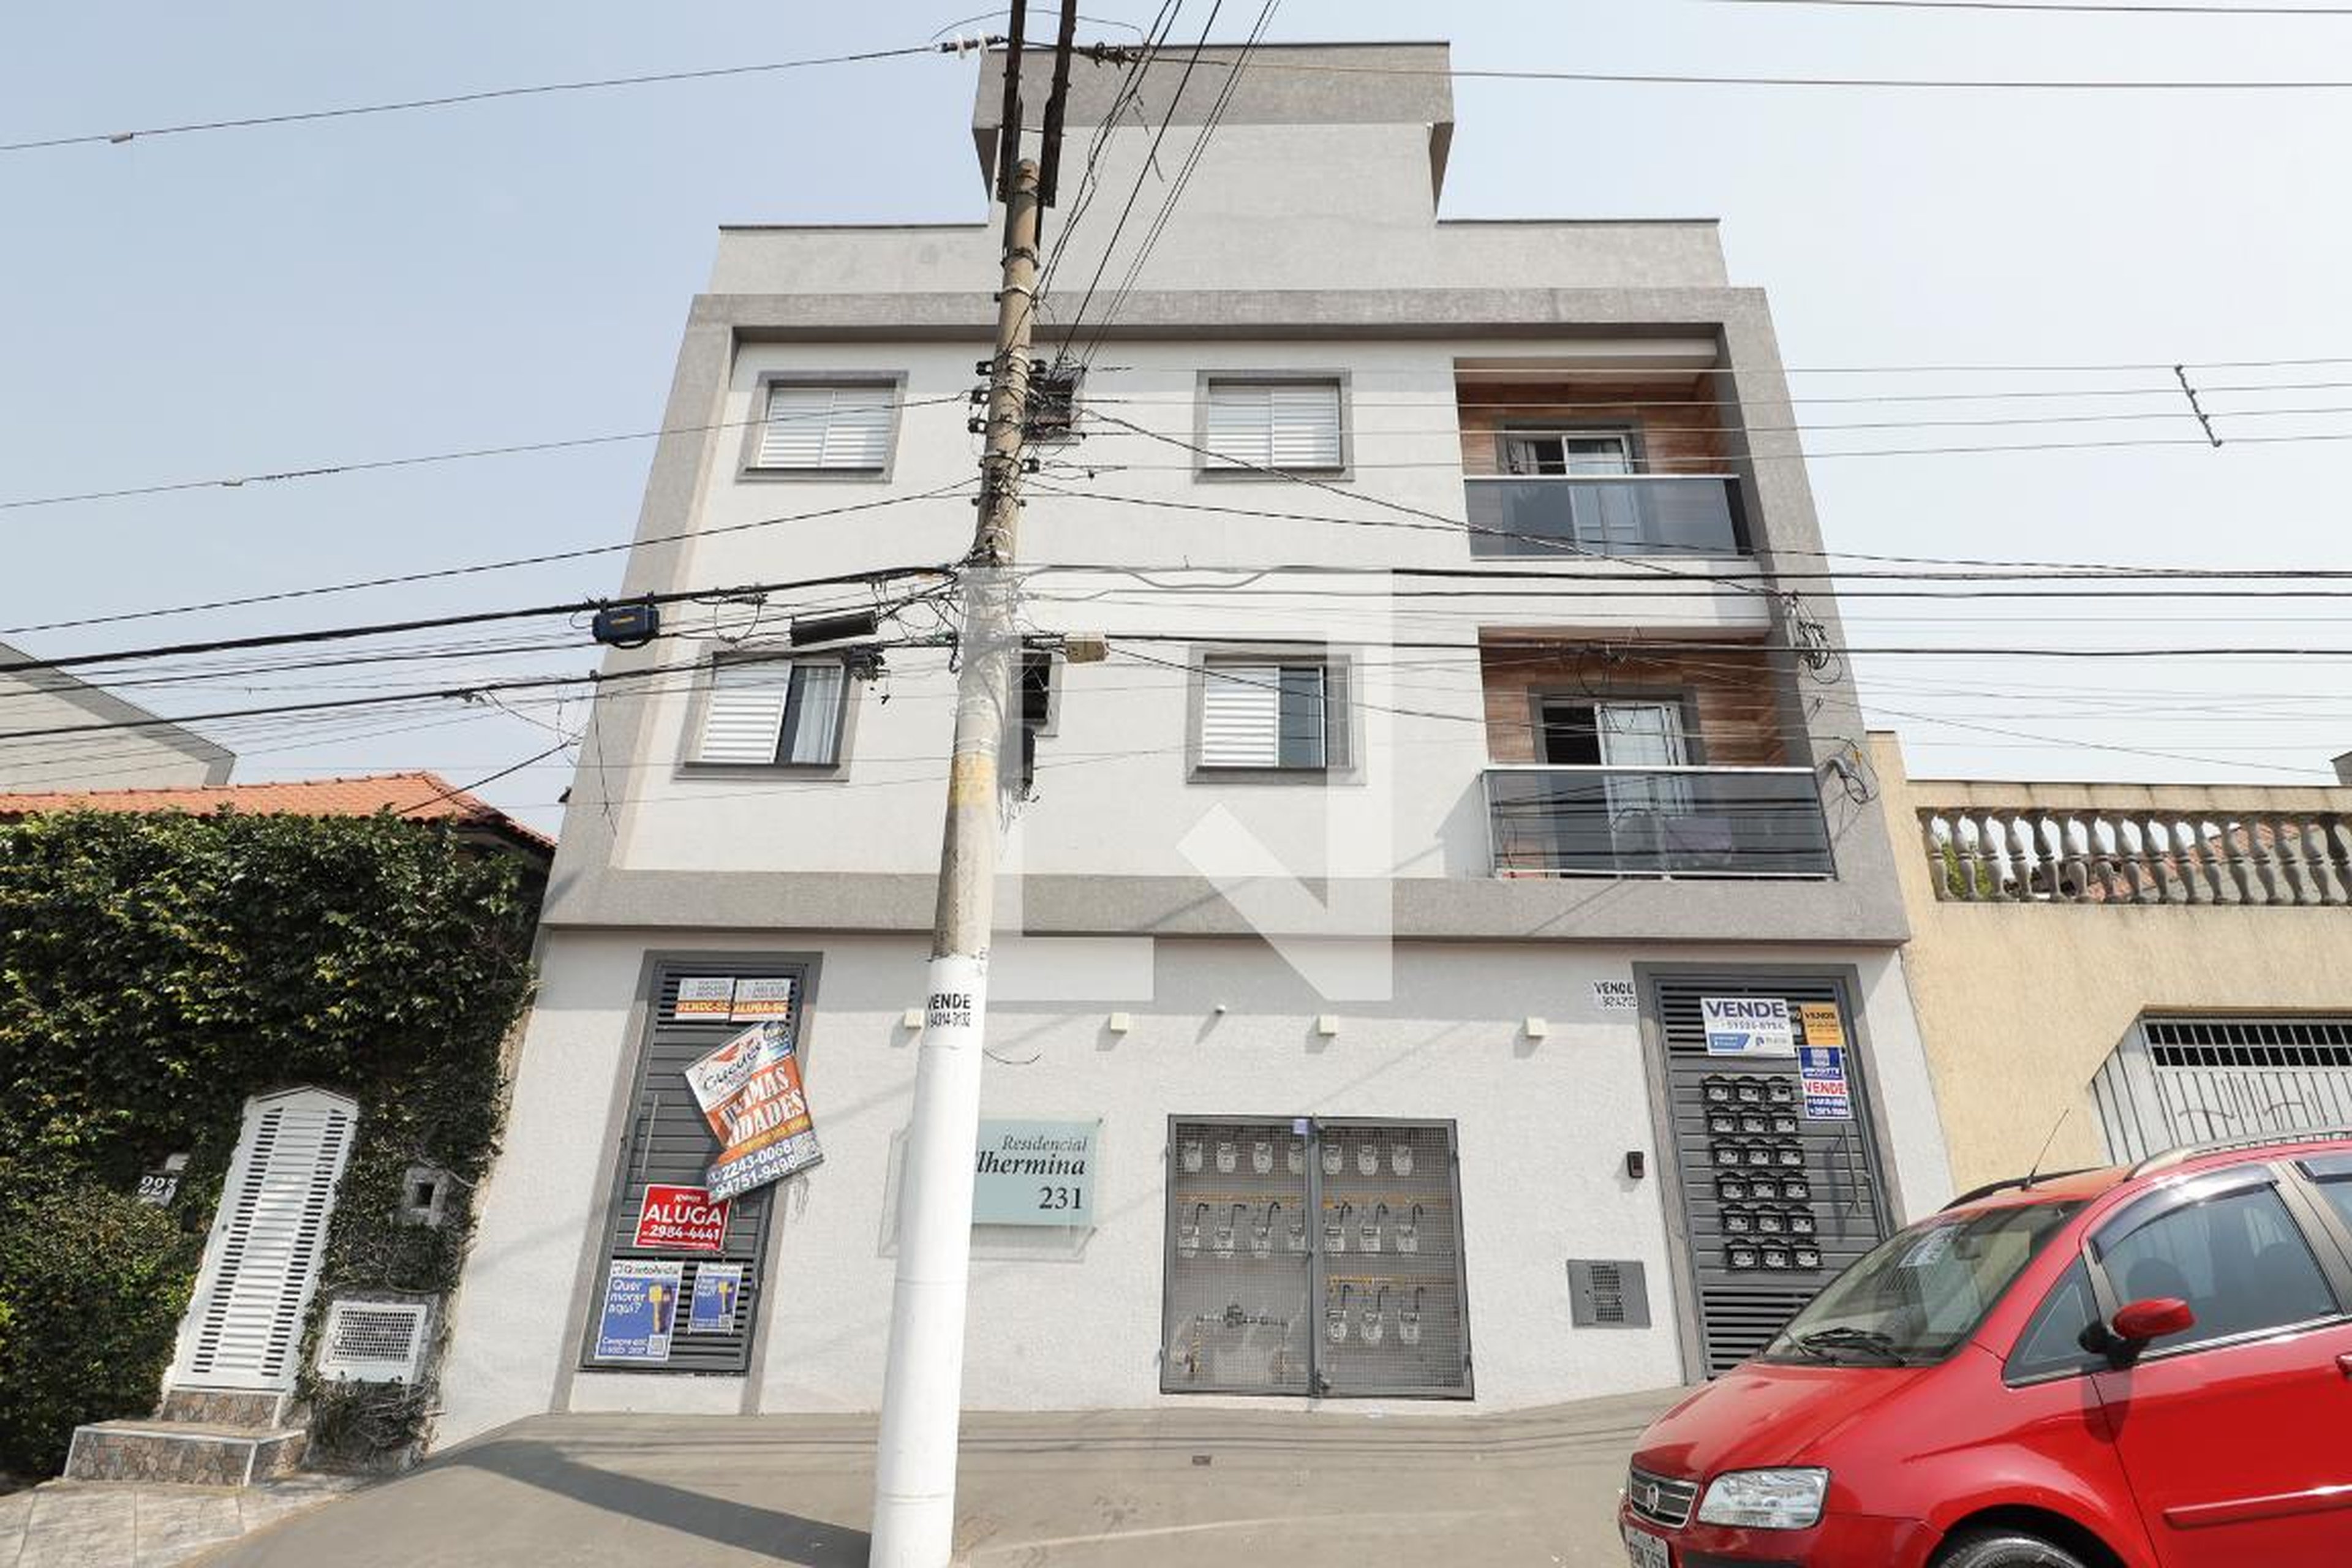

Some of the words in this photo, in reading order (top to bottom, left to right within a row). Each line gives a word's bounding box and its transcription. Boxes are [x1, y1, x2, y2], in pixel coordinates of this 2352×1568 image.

[927, 993, 971, 1011] VENDE
[1705, 1001, 1787, 1018] VENDE
[1804, 1081, 1847, 1095] VENDE
[1002, 1134, 1088, 1152] Residencial
[977, 1150, 1086, 1175] lhermina
[1038, 1186, 1082, 1210] 231
[644, 1203, 722, 1226] ALUGA
